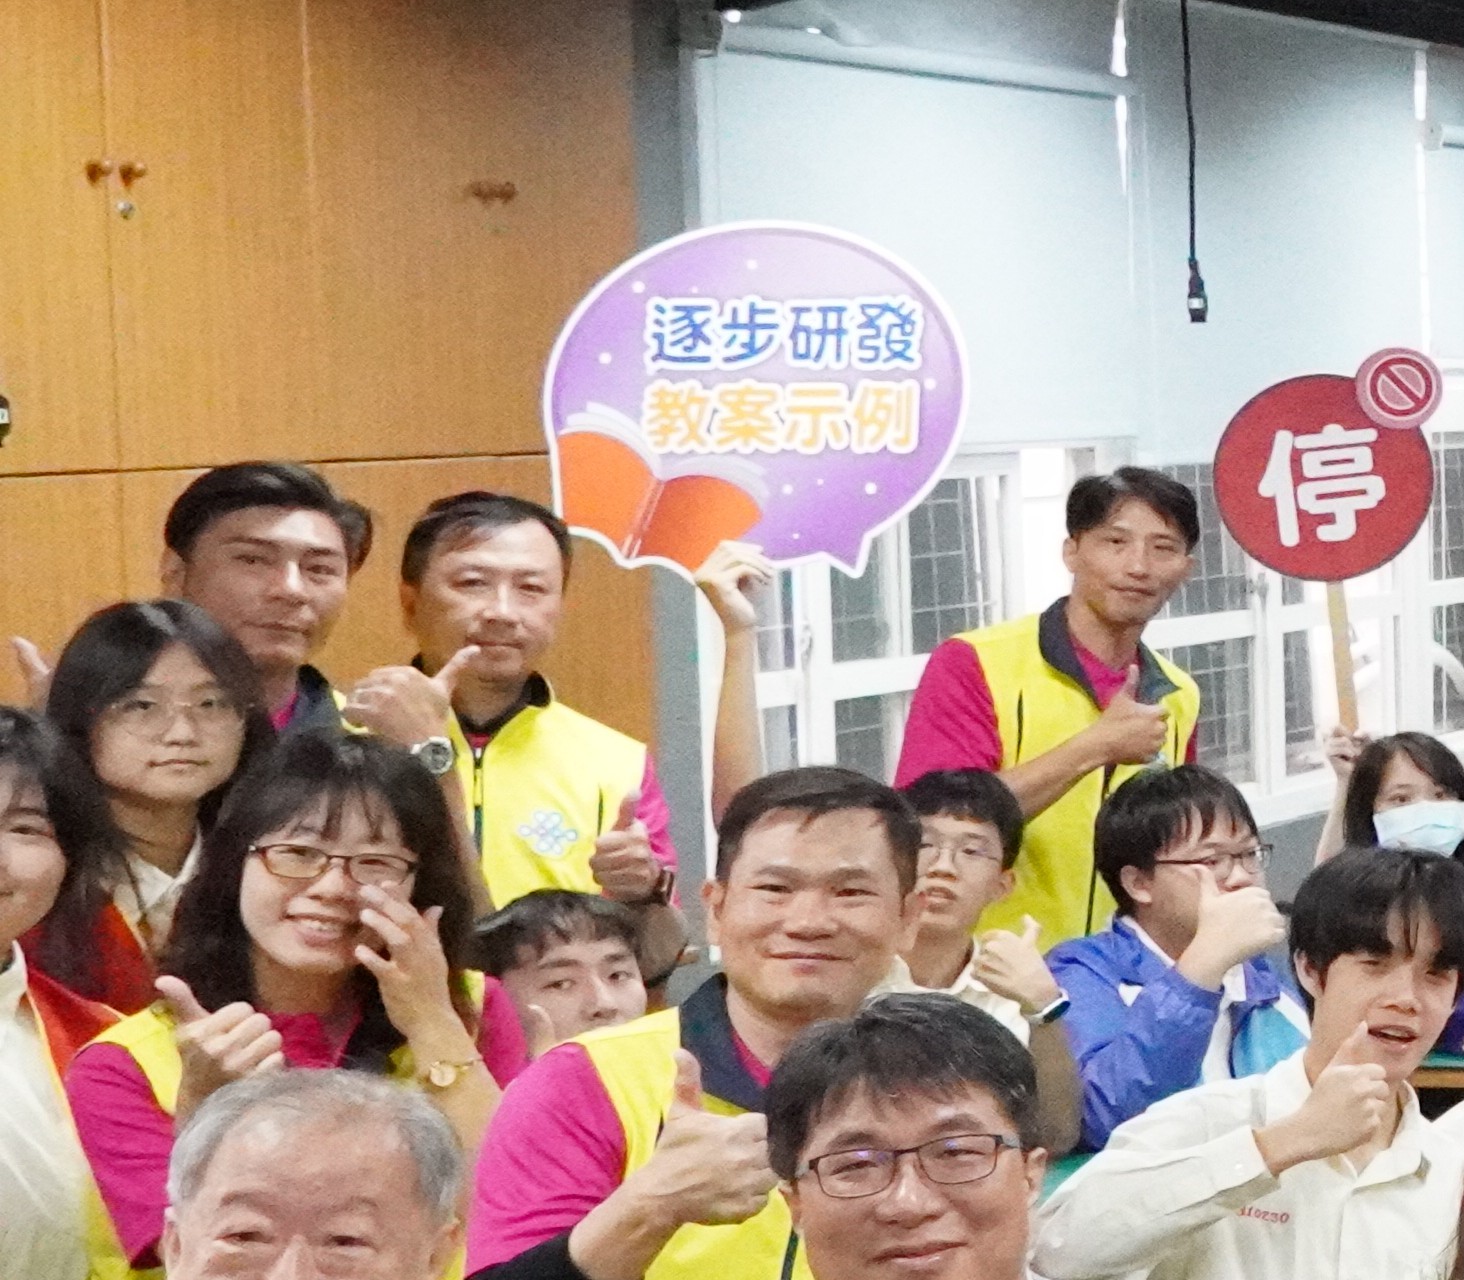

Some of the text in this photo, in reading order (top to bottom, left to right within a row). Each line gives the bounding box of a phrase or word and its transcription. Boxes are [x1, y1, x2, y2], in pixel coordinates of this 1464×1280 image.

[650, 303, 919, 366] 逐步研發
[647, 383, 919, 452] 教案示例
[1258, 424, 1385, 547] 停
